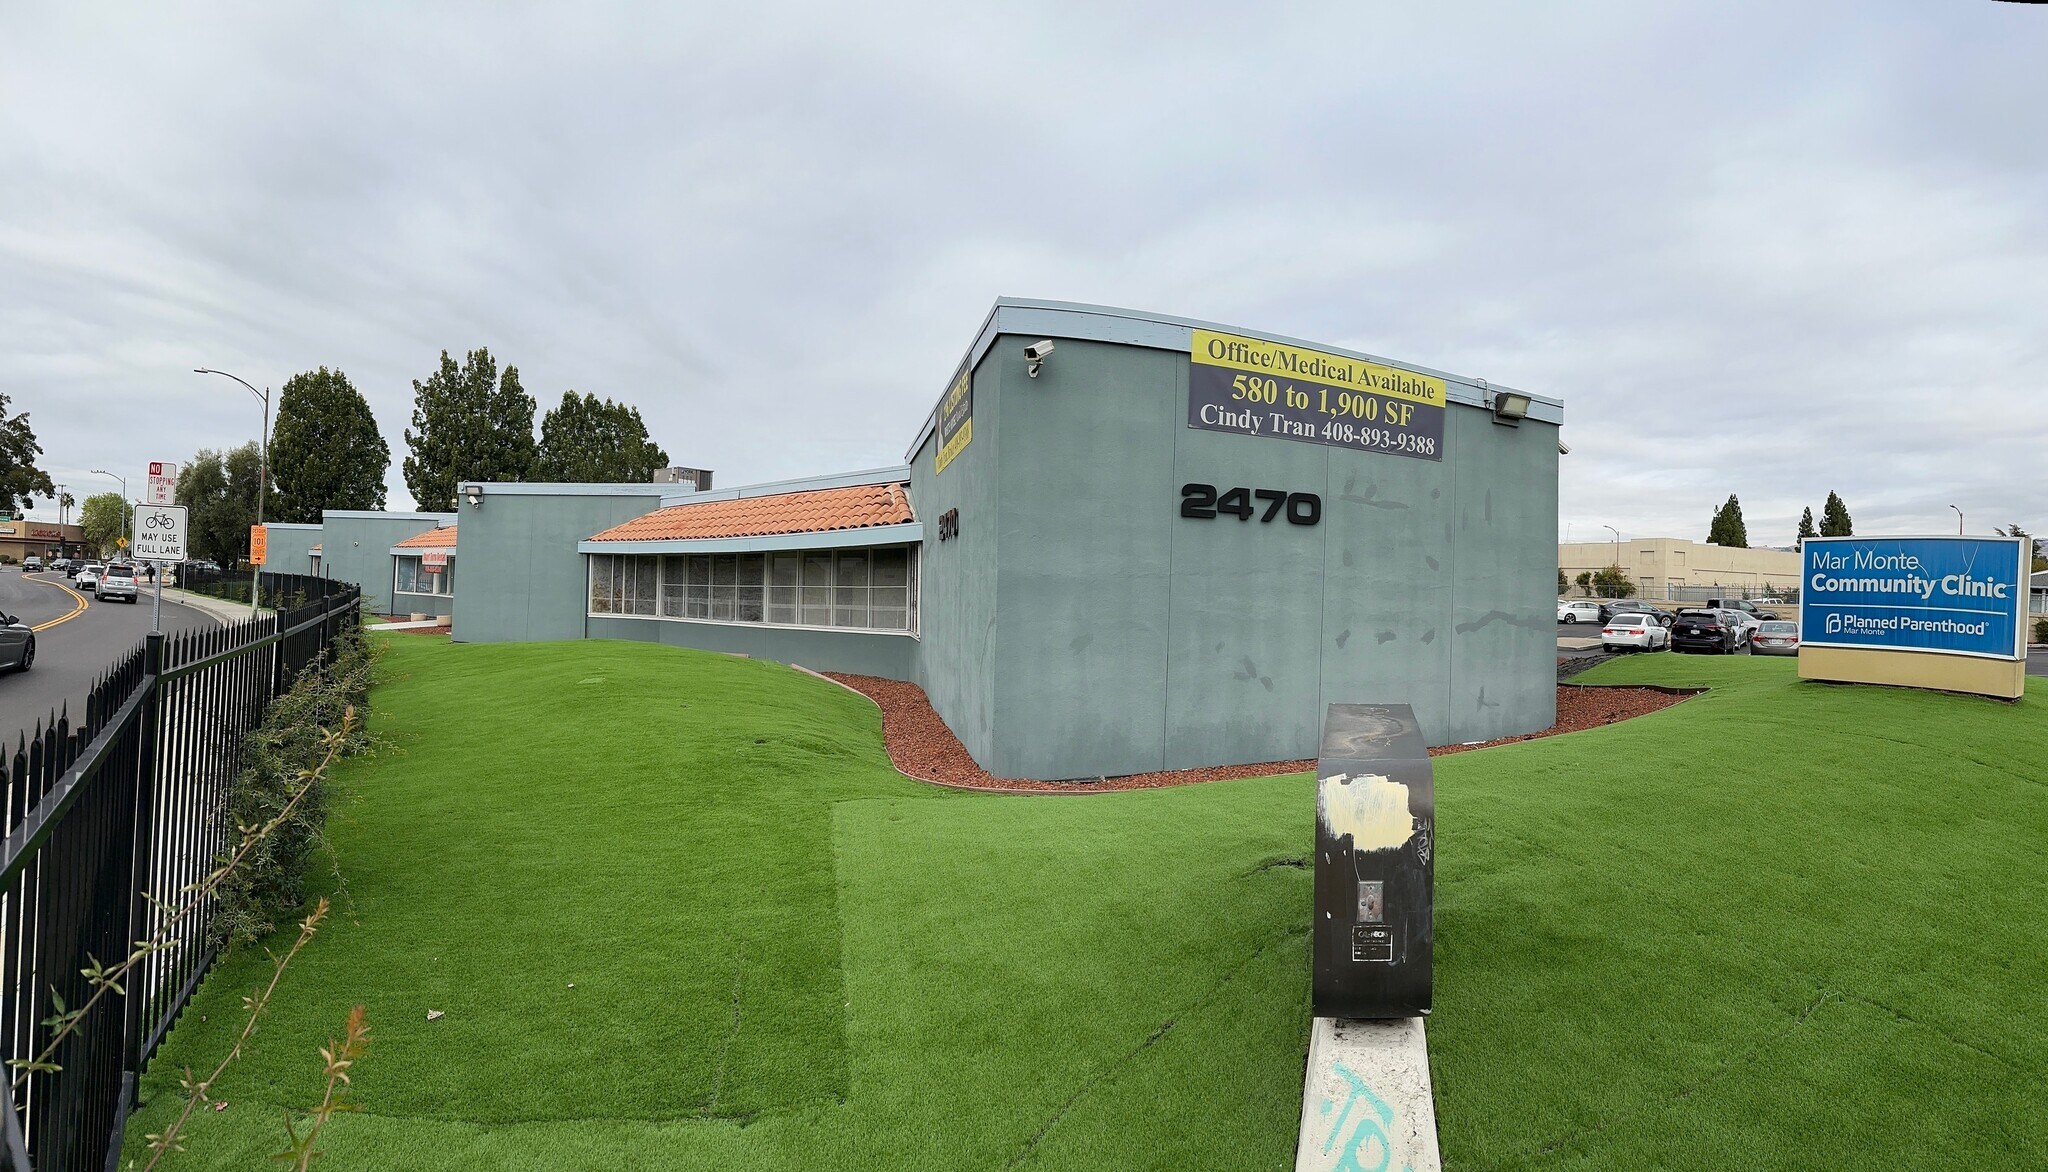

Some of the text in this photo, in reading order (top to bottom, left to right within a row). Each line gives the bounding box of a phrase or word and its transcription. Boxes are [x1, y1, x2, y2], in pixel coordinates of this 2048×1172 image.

[1207, 338, 1435, 399] Office/Medical Available
[1232, 374, 1415, 427] 580 to 1,900 SF
[1200, 403, 1435, 455] Cindy Tran 408-893-9388
[150, 463, 161, 474] NO
[150, 476, 174, 486] STOPPING
[1180, 483, 1321, 525] 2470
[141, 532, 177, 542] MAY USE
[253, 538, 264, 546] 101
[137, 544, 181, 554] FULL LANE
[1812, 551, 1919, 570] Mar Monte
[1811, 573, 2008, 599] Community Clinic
[1844, 614, 1985, 636] Planned Parenthood
[1860, 628, 1885, 636] Monte
